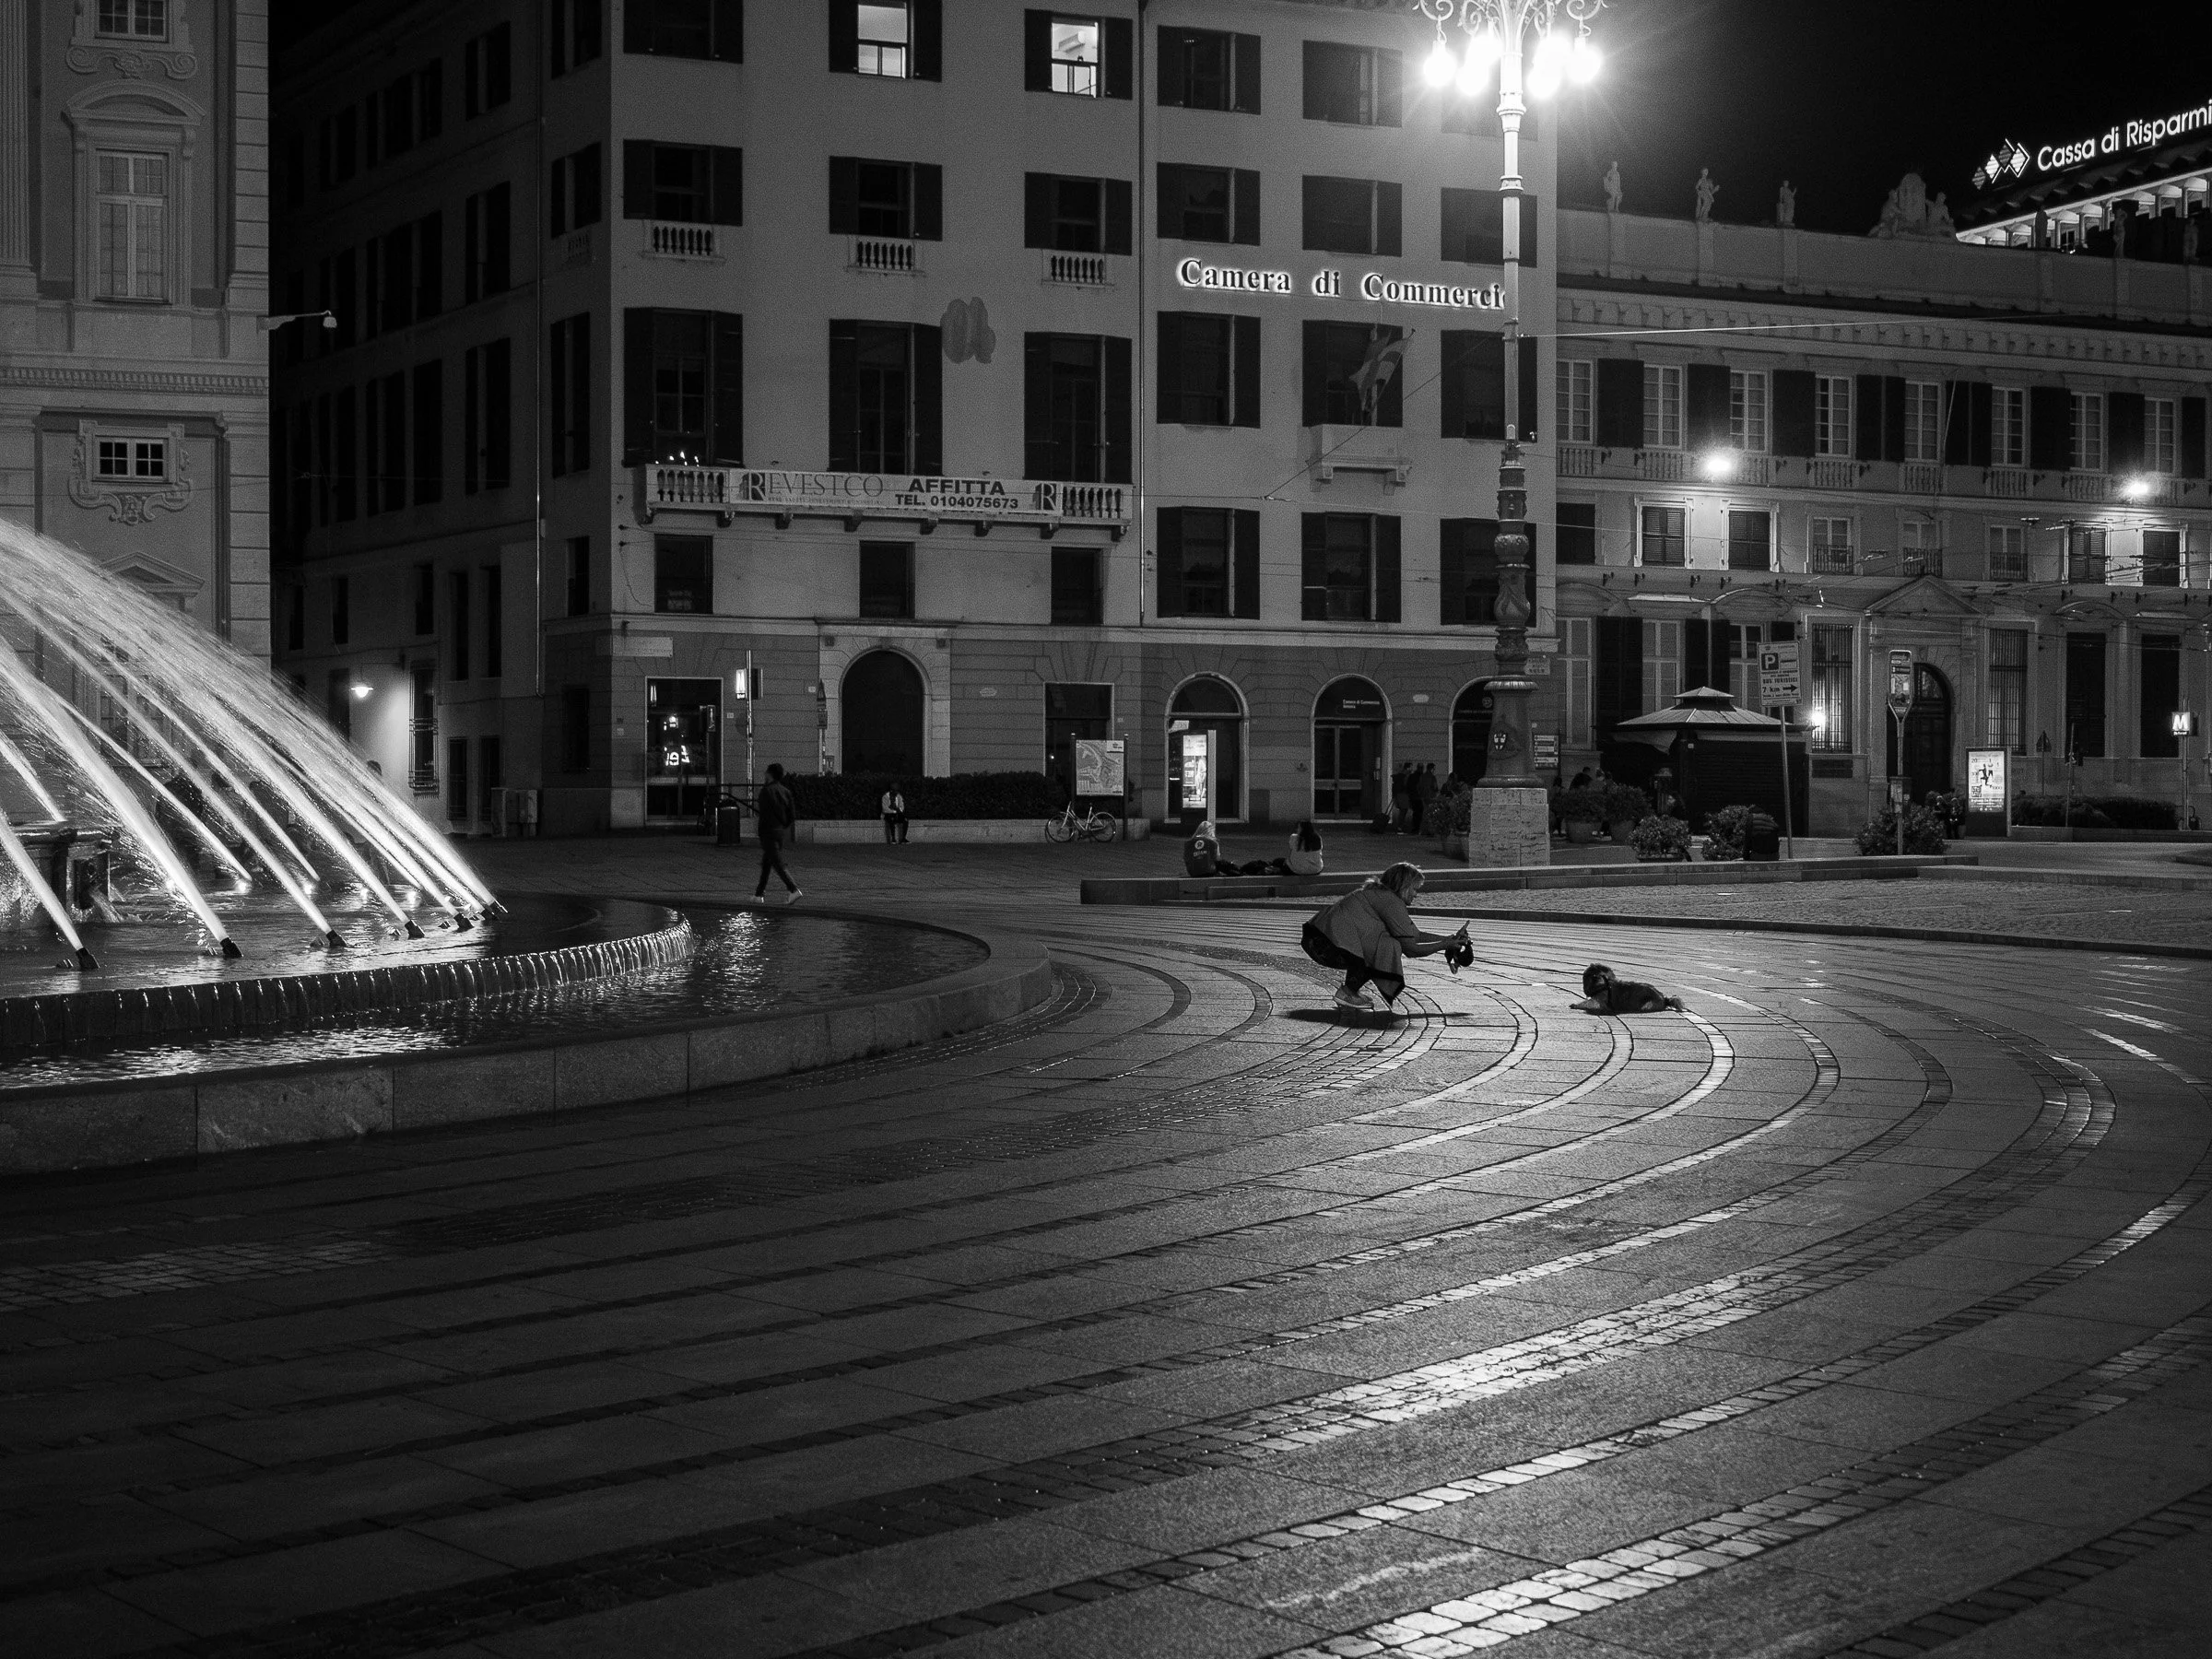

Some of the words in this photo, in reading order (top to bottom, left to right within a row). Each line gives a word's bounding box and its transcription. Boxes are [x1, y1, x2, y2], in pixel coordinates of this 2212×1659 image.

[2037, 138, 2095, 171] Cassa
[2100, 126, 2120, 154] di
[1178, 258, 1291, 293] Camera
[1313, 269, 1341, 297] di
[1362, 273, 1505, 310] Commerci
[740, 471, 883, 501] REVESTCO
[908, 477, 1006, 496] AFFITTA
[895, 493, 926, 506] TEL.
[930, 495, 1019, 509] 0104075673
[1764, 654, 1776, 670] P
